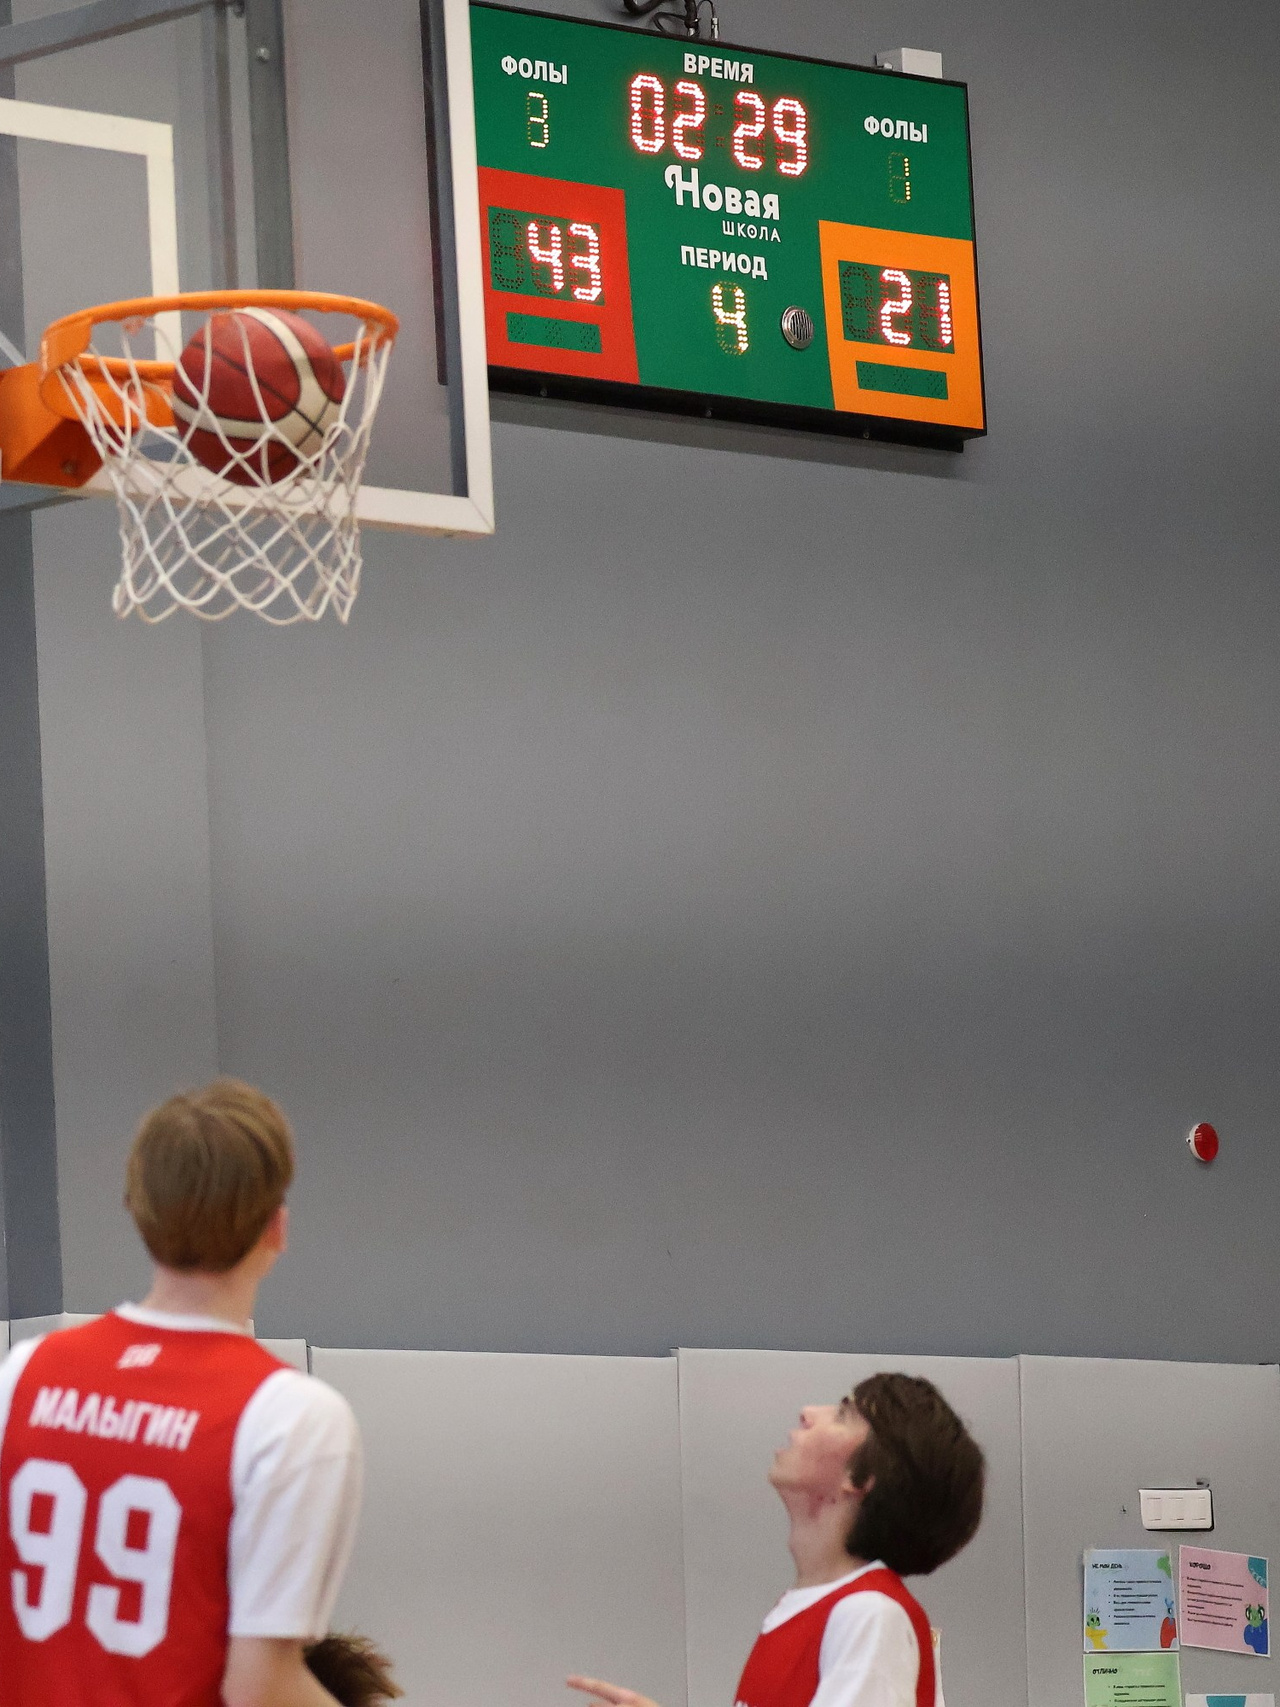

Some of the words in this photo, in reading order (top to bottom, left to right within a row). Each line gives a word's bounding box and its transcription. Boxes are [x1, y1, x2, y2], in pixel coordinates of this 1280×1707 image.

[501, 55, 568, 85] ФОЛЫ
[683, 53, 754, 83] ВРЕМЯ
[528, 91, 549, 148] 3
[864, 116, 928, 144] ФОЛЫ
[664, 164, 780, 221] Новая
[528, 220, 602, 301] 43
[680, 245, 768, 280] ПЕРИОД
[711, 283, 748, 353] 4
[880, 269, 950, 346] 21
[29, 1386, 201, 1452] МАЛЫГИН
[8, 1458, 181, 1658] 99
